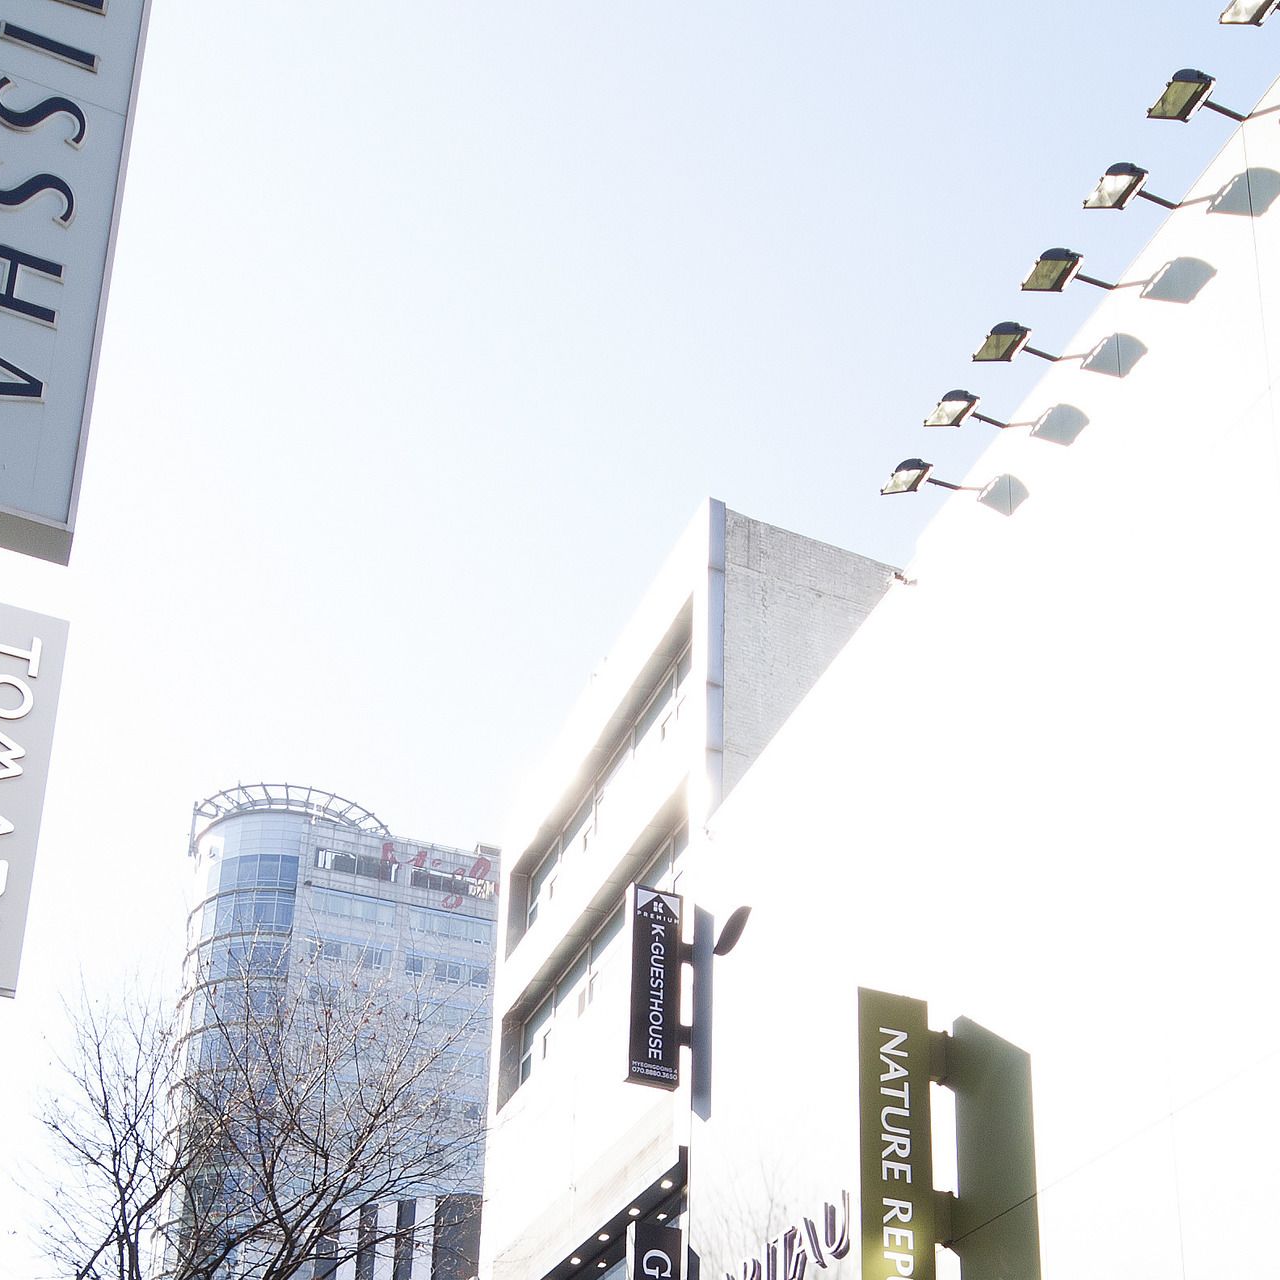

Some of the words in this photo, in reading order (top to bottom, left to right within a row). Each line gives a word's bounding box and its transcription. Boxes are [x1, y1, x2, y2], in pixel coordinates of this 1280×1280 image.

[636, 910, 680, 925] PREMIUM
[647, 923, 665, 1060] K-GUESTHOUSE
[879, 1026, 912, 1184] NATURE
